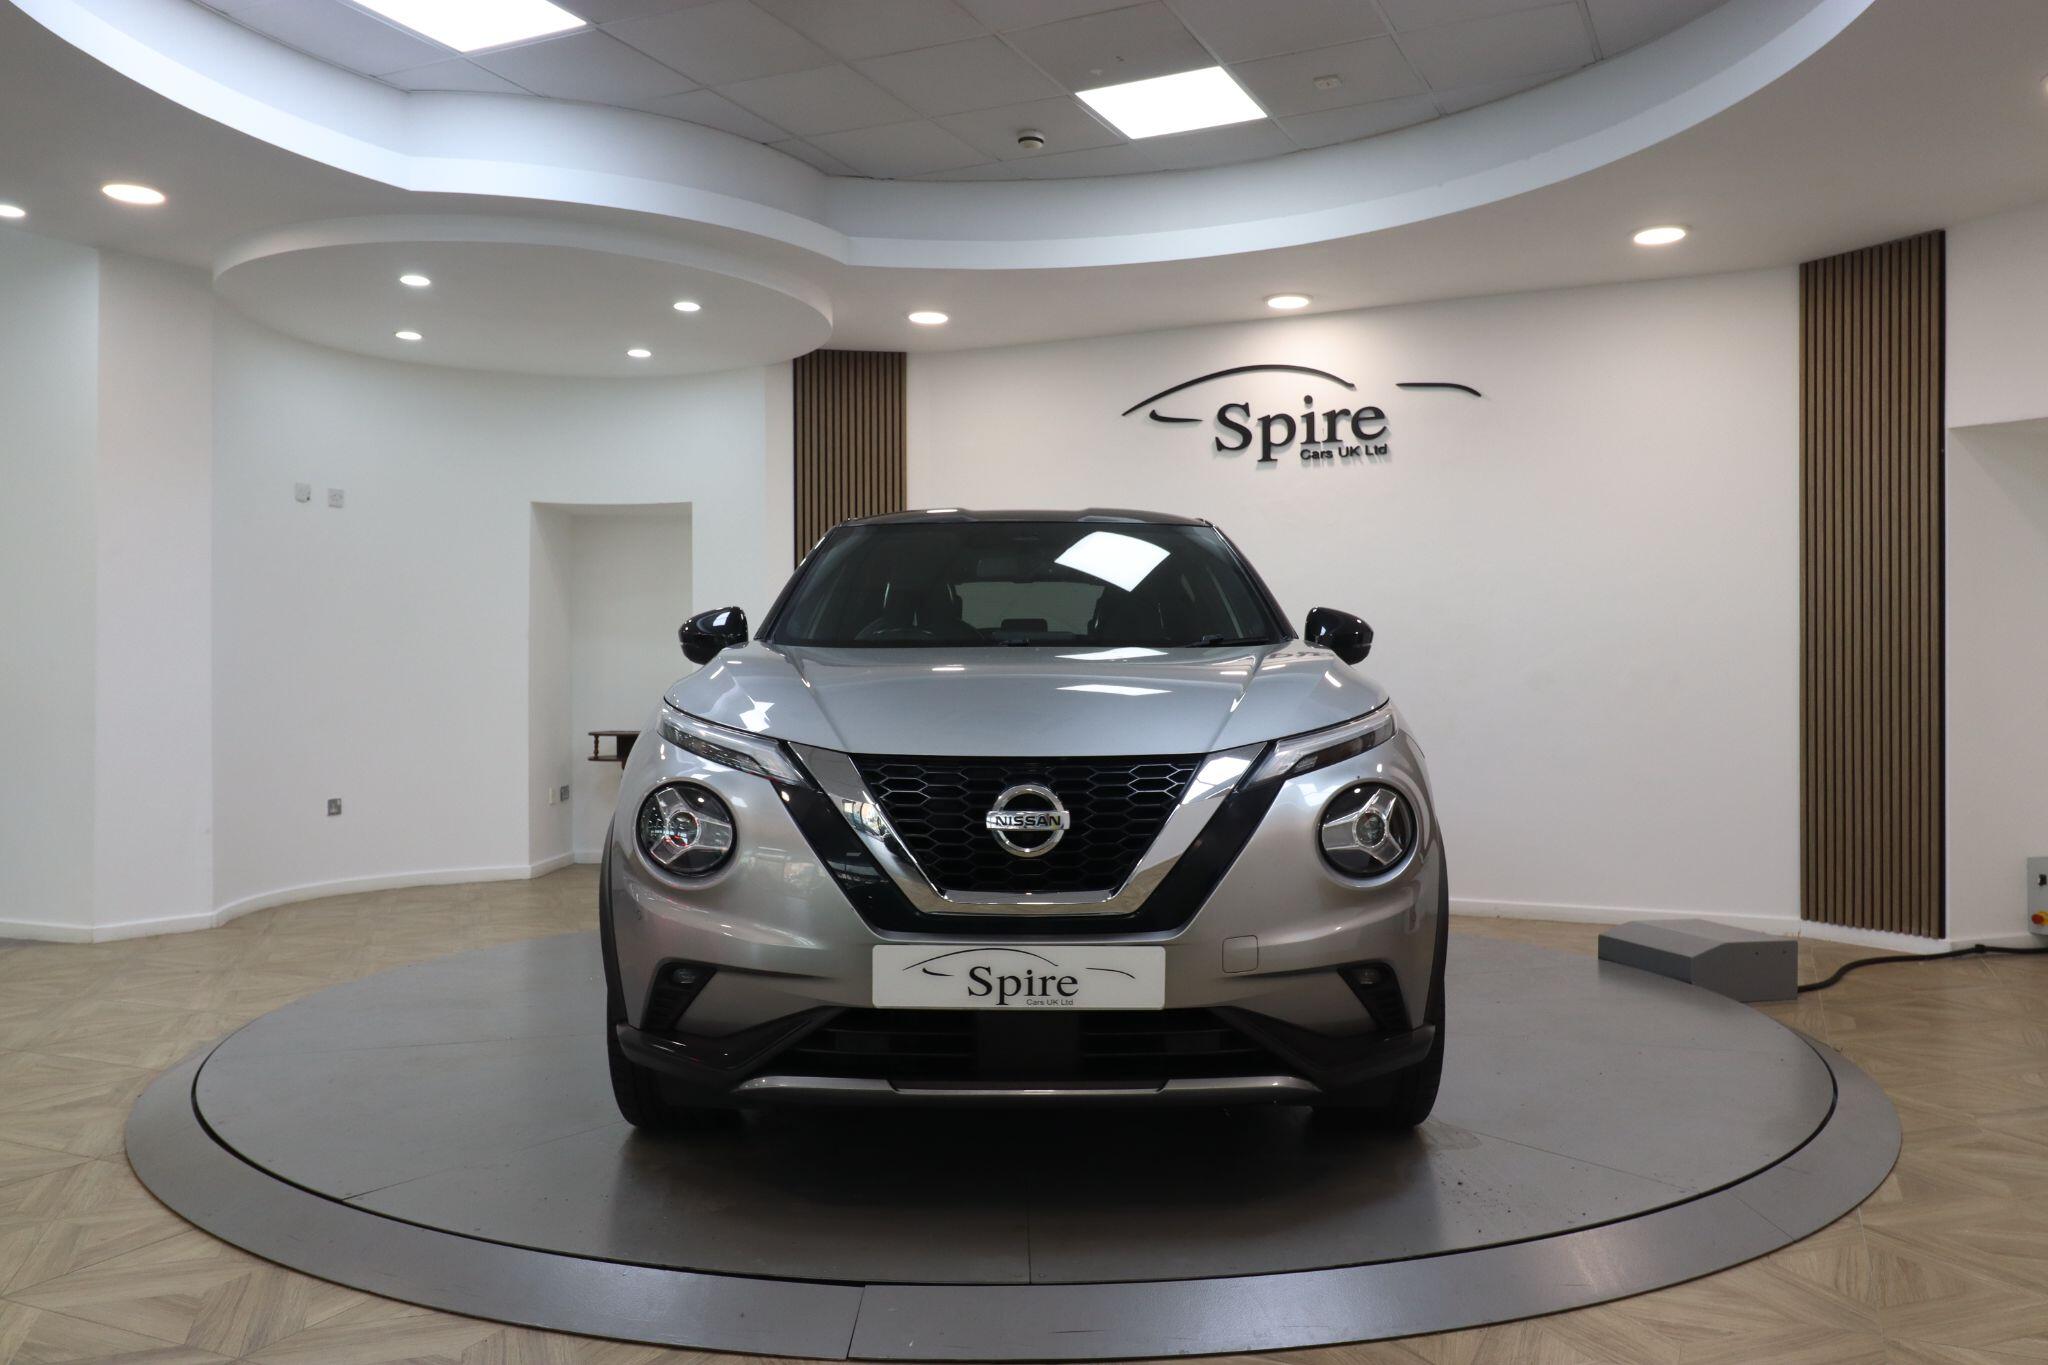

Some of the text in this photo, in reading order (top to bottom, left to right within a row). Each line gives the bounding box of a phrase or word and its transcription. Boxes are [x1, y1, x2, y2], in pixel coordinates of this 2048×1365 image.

[1214, 395, 1387, 462] Spire
[1300, 443, 1388, 460] Cars UK Ltd
[995, 815, 1061, 826] NISSAN
[968, 966, 1079, 1005] Spire
